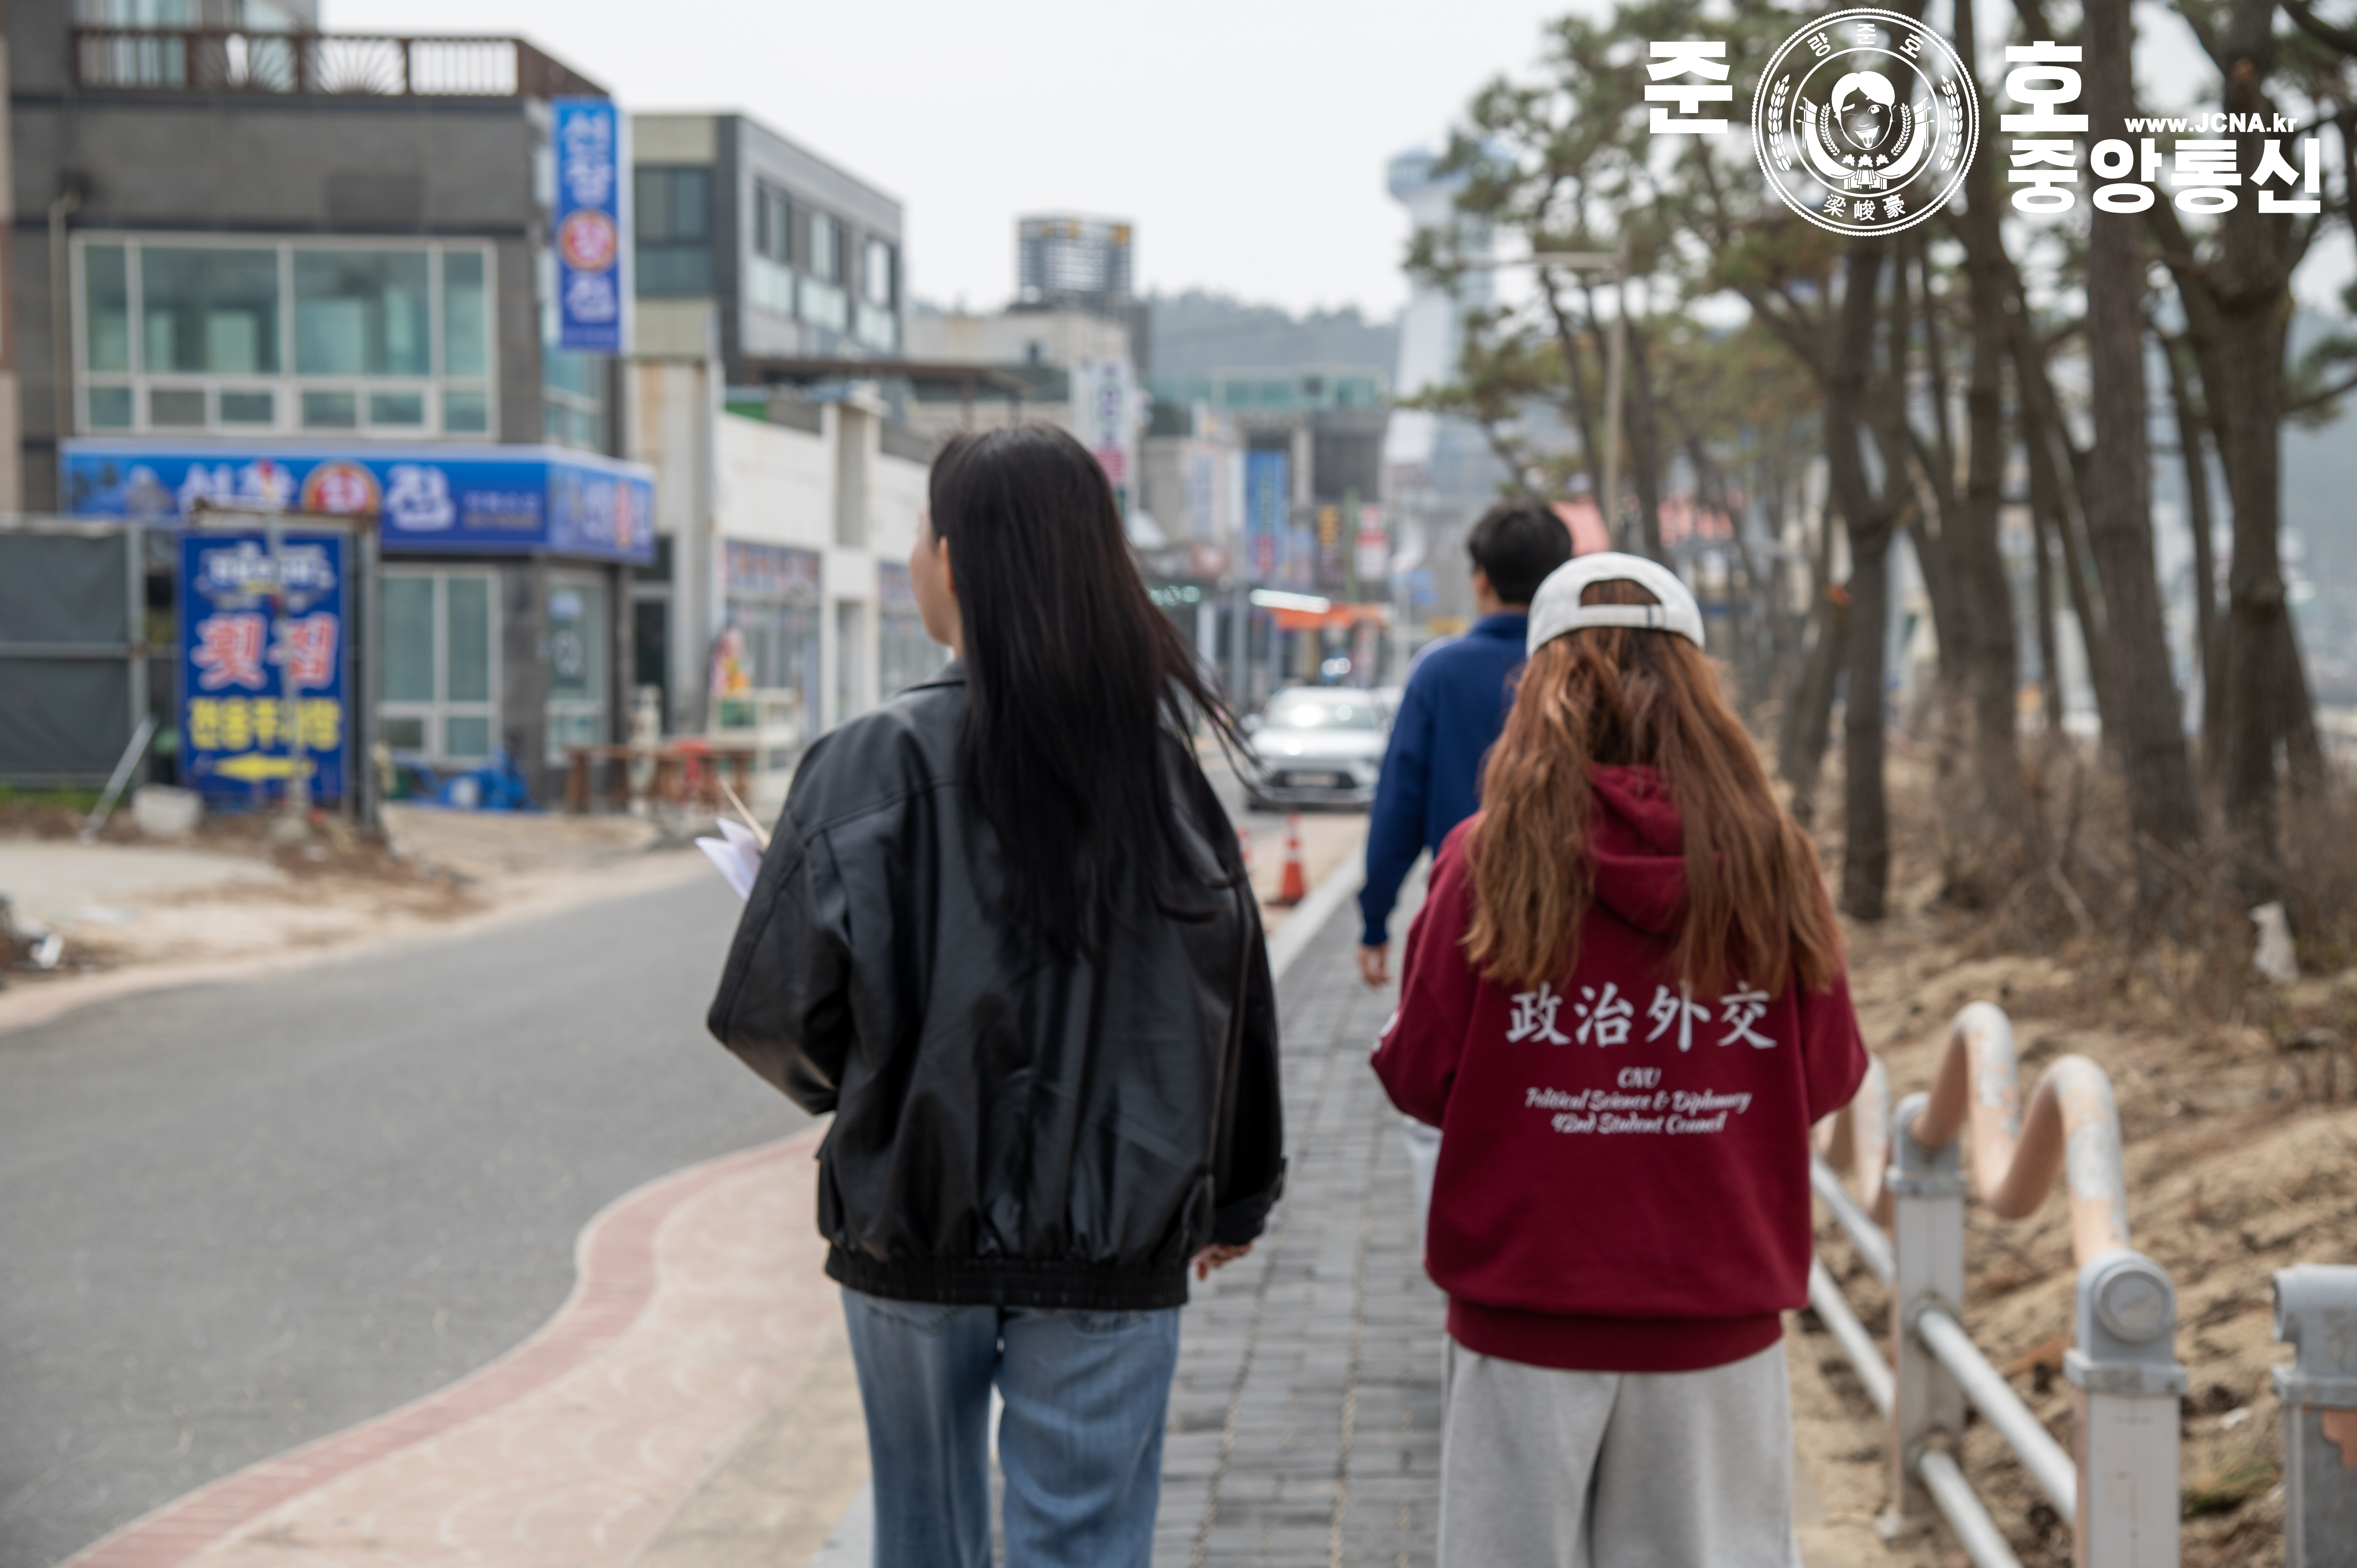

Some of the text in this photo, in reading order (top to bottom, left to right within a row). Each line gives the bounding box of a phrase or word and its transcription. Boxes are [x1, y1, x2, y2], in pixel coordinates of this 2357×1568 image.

[189, 611, 339, 690] 횟집
[1505, 979, 1778, 1053] 政治外交
[1617, 1066, 1662, 1089] CNU
[1525, 1087, 1752, 1117] Political Science & Diplomacy
[1551, 1110, 1728, 1135] 42nd Student Council
